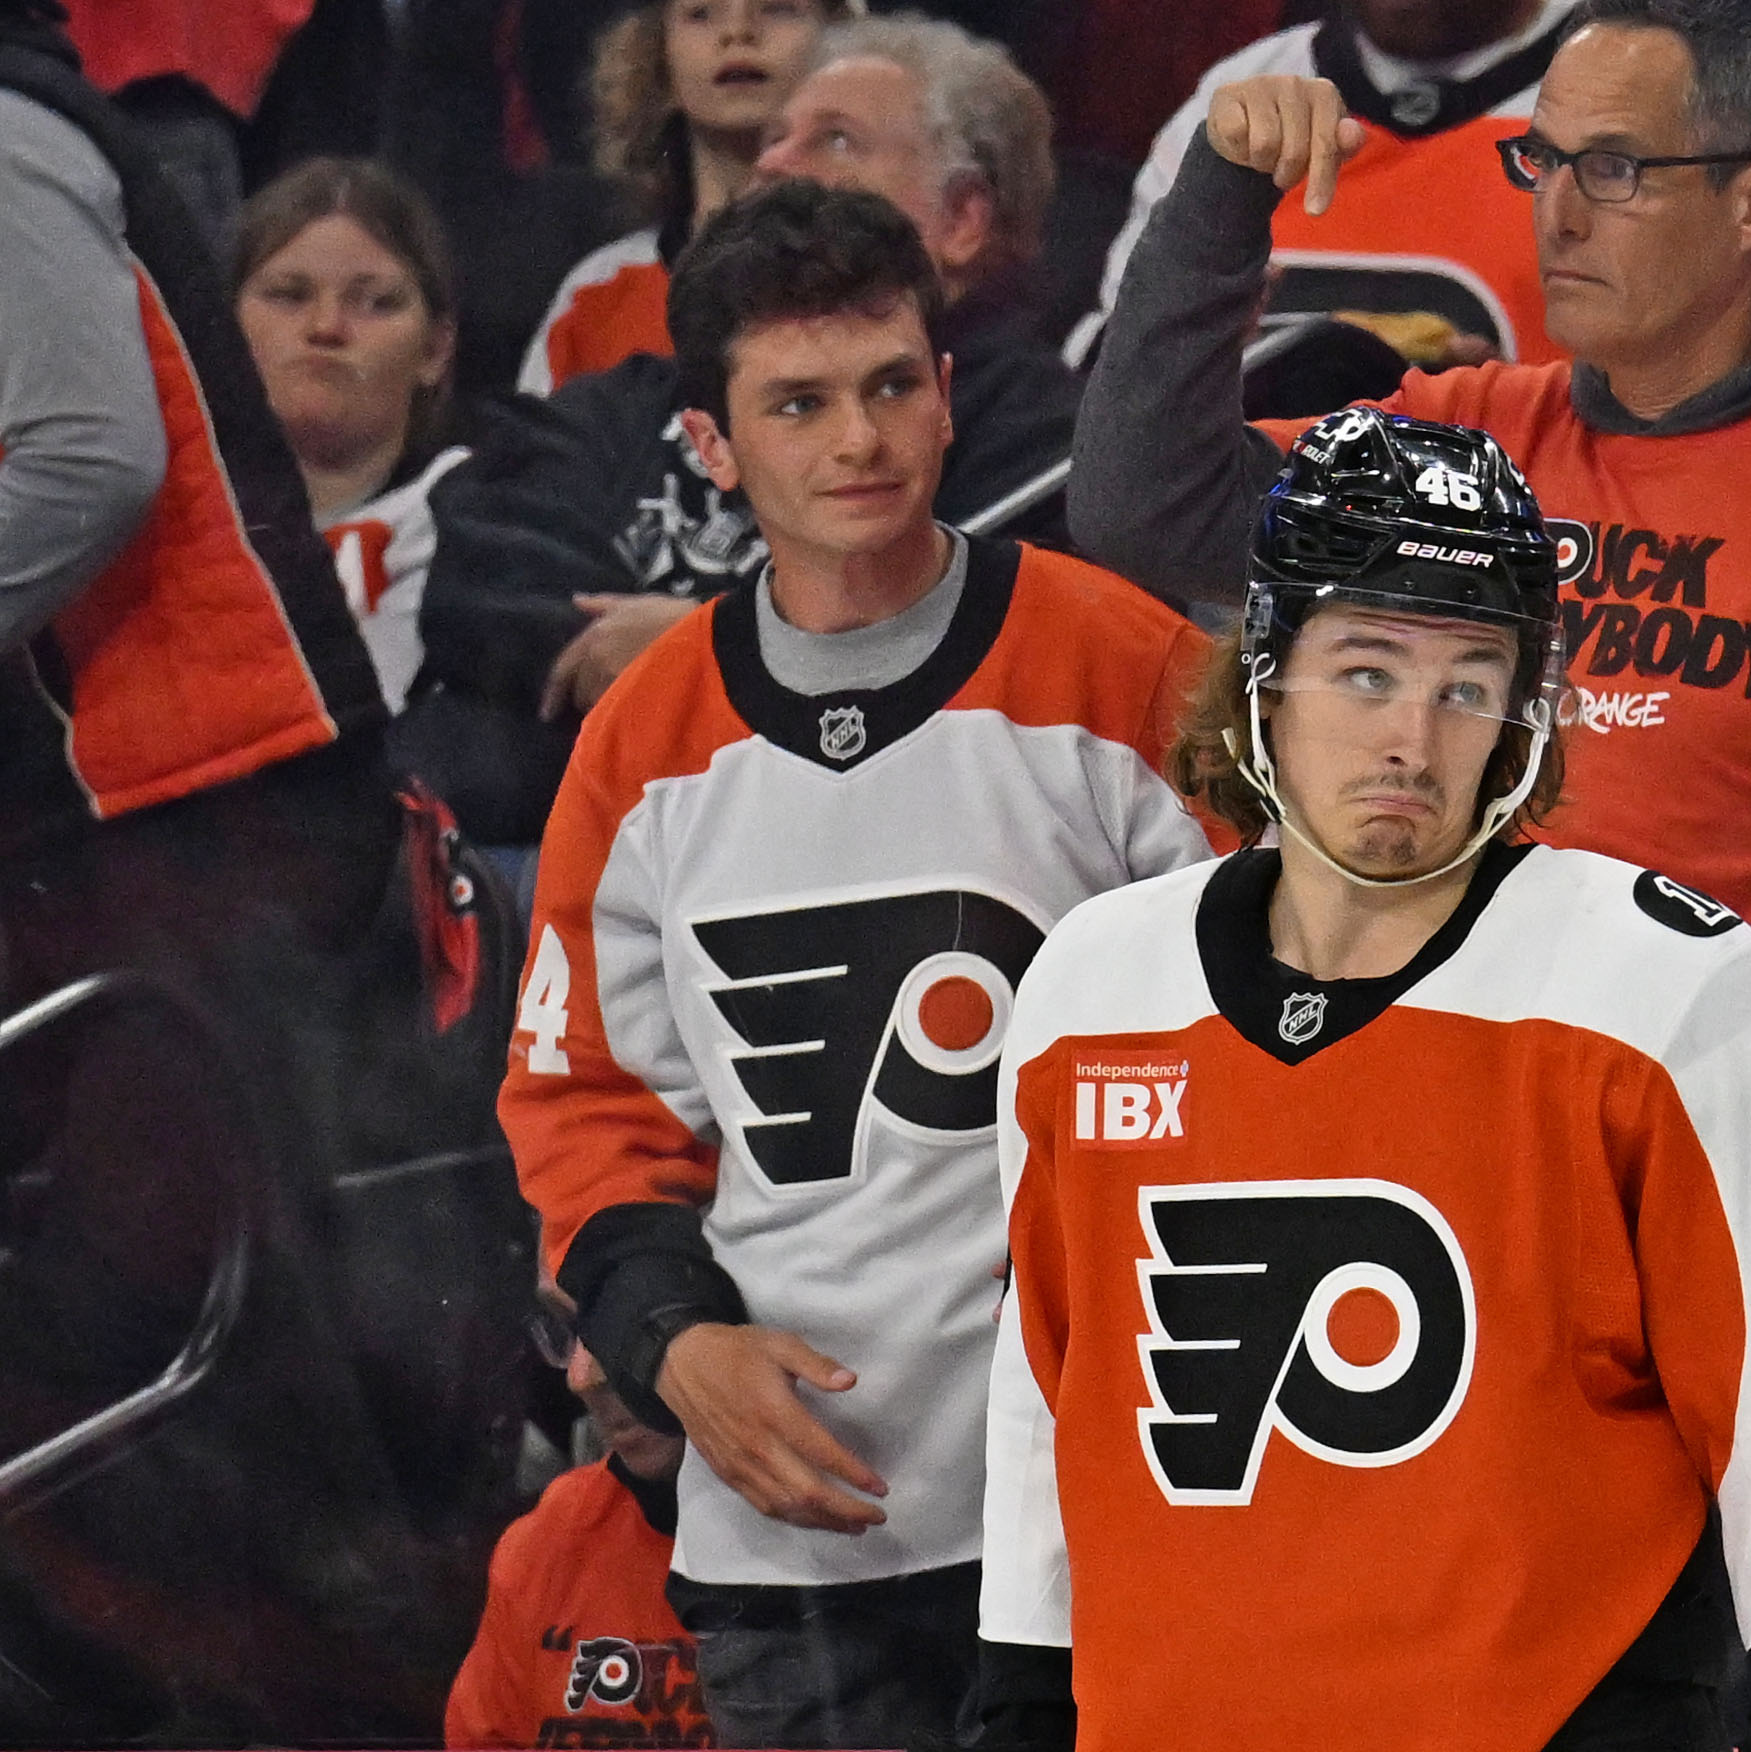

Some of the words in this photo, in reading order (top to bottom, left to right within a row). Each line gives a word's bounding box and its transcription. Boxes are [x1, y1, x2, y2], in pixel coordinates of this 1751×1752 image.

[1415, 466, 1483, 512] 46
[1397, 541, 1494, 568] BAUER
[1076, 1062, 1179, 1079] Independence
[1075, 1080, 1188, 1140] IBX
